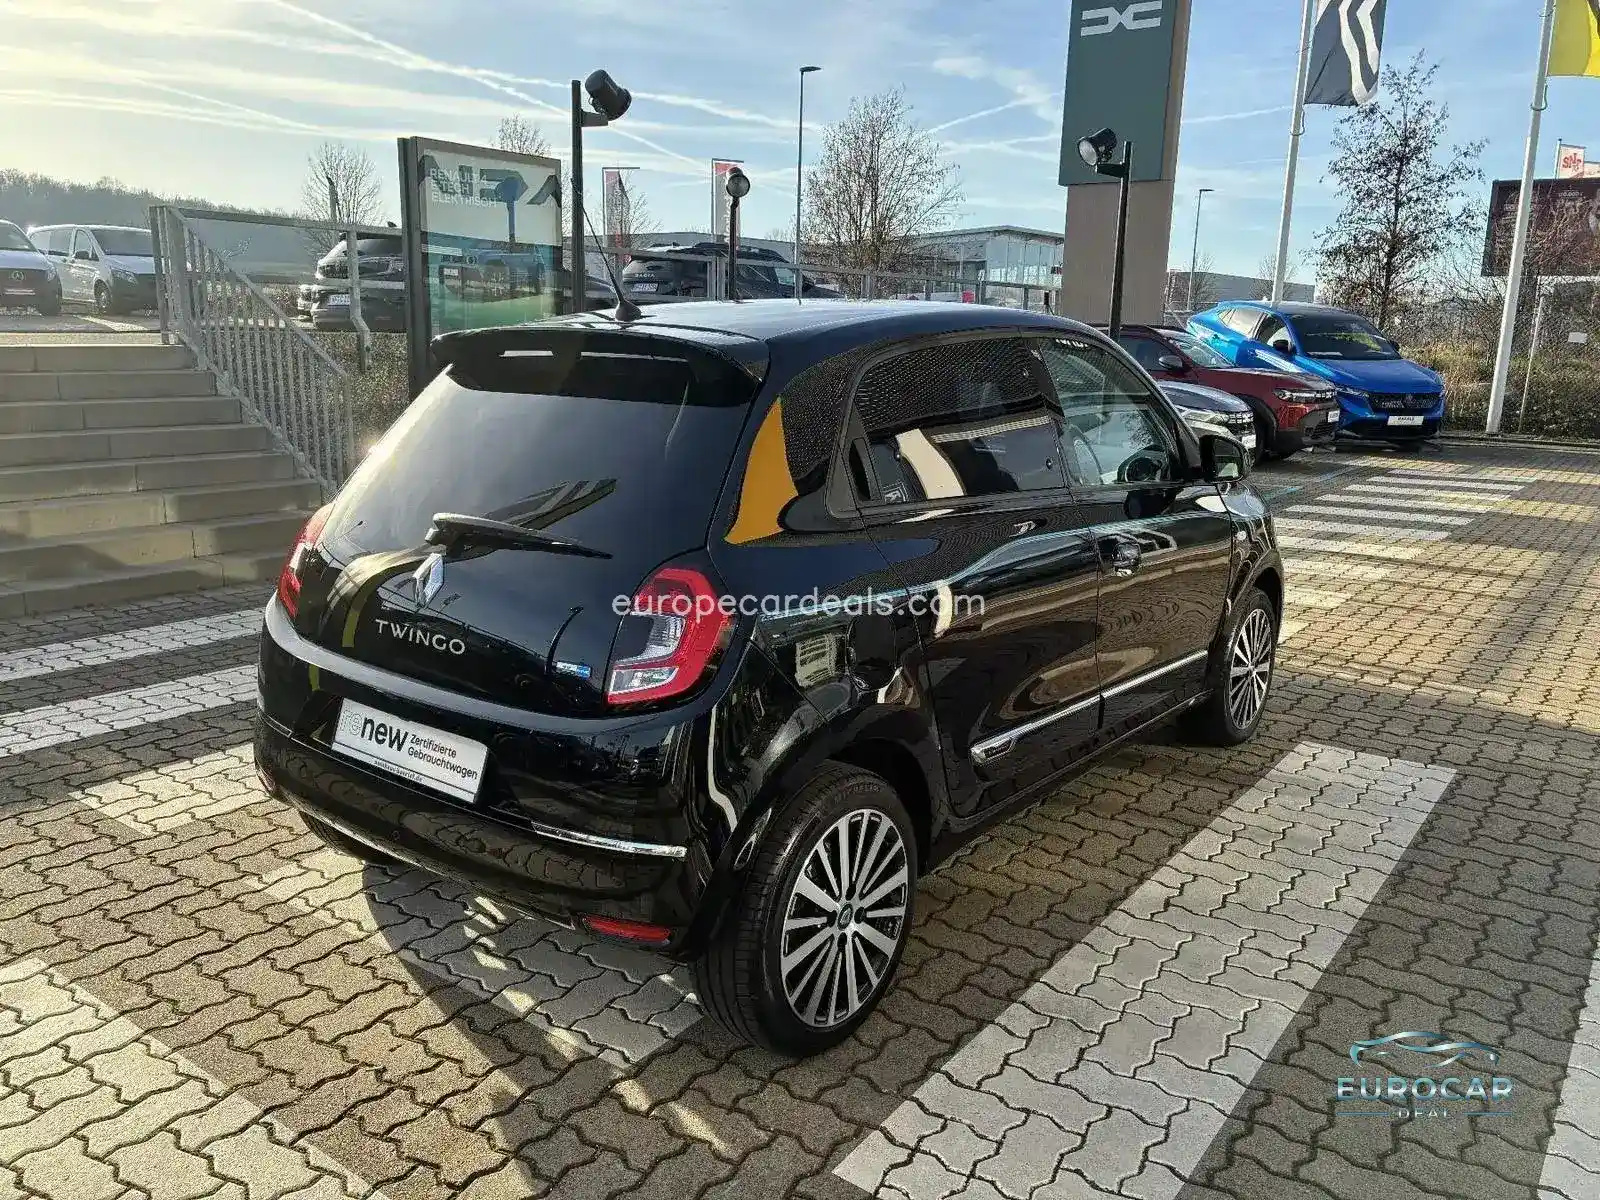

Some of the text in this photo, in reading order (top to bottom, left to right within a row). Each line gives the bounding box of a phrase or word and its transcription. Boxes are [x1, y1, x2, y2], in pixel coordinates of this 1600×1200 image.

[430, 168, 479, 183] RENAULT
[375, 618, 466, 655] TWINGO
[410, 733, 457, 759] Zertifizierte
[407, 747, 478, 780] Gebrauchtwagen
